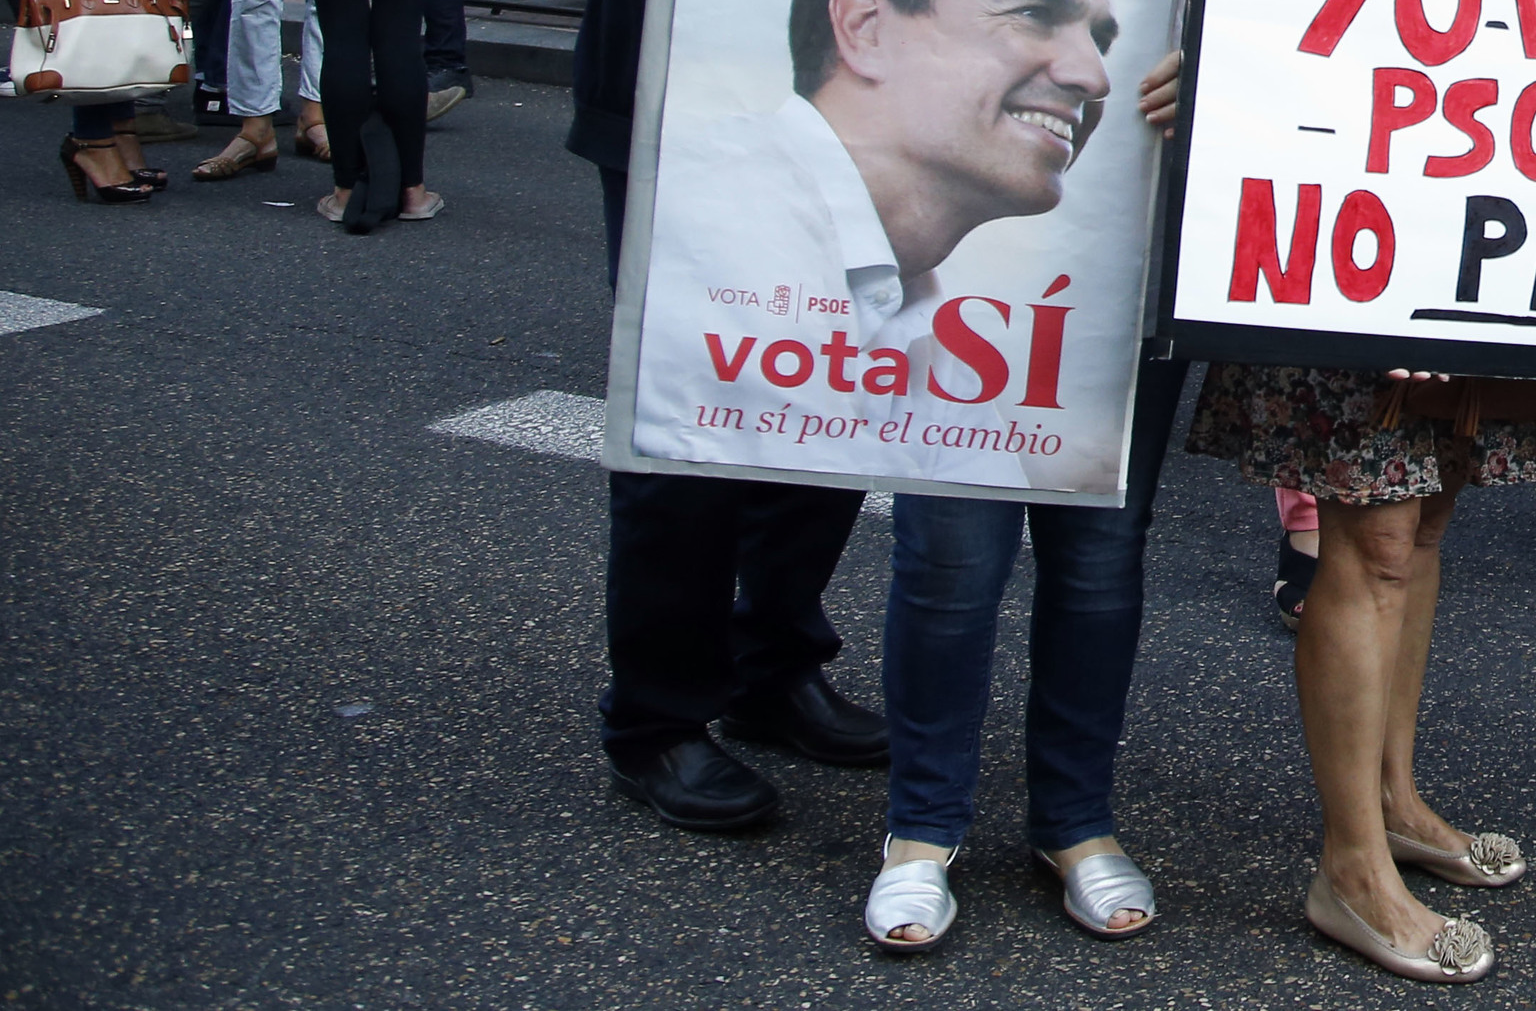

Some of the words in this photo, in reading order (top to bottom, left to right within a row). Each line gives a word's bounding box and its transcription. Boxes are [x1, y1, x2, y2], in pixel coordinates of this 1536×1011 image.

[1227, 176, 1397, 305] NO
[708, 286, 760, 307] VOTA
[807, 296, 851, 315] PSOE
[696, 403, 745, 431] un
[756, 402, 789, 435] sí
[796, 413, 869, 446] por
[879, 413, 911, 445] el
[922, 420, 1062, 457] cambio
